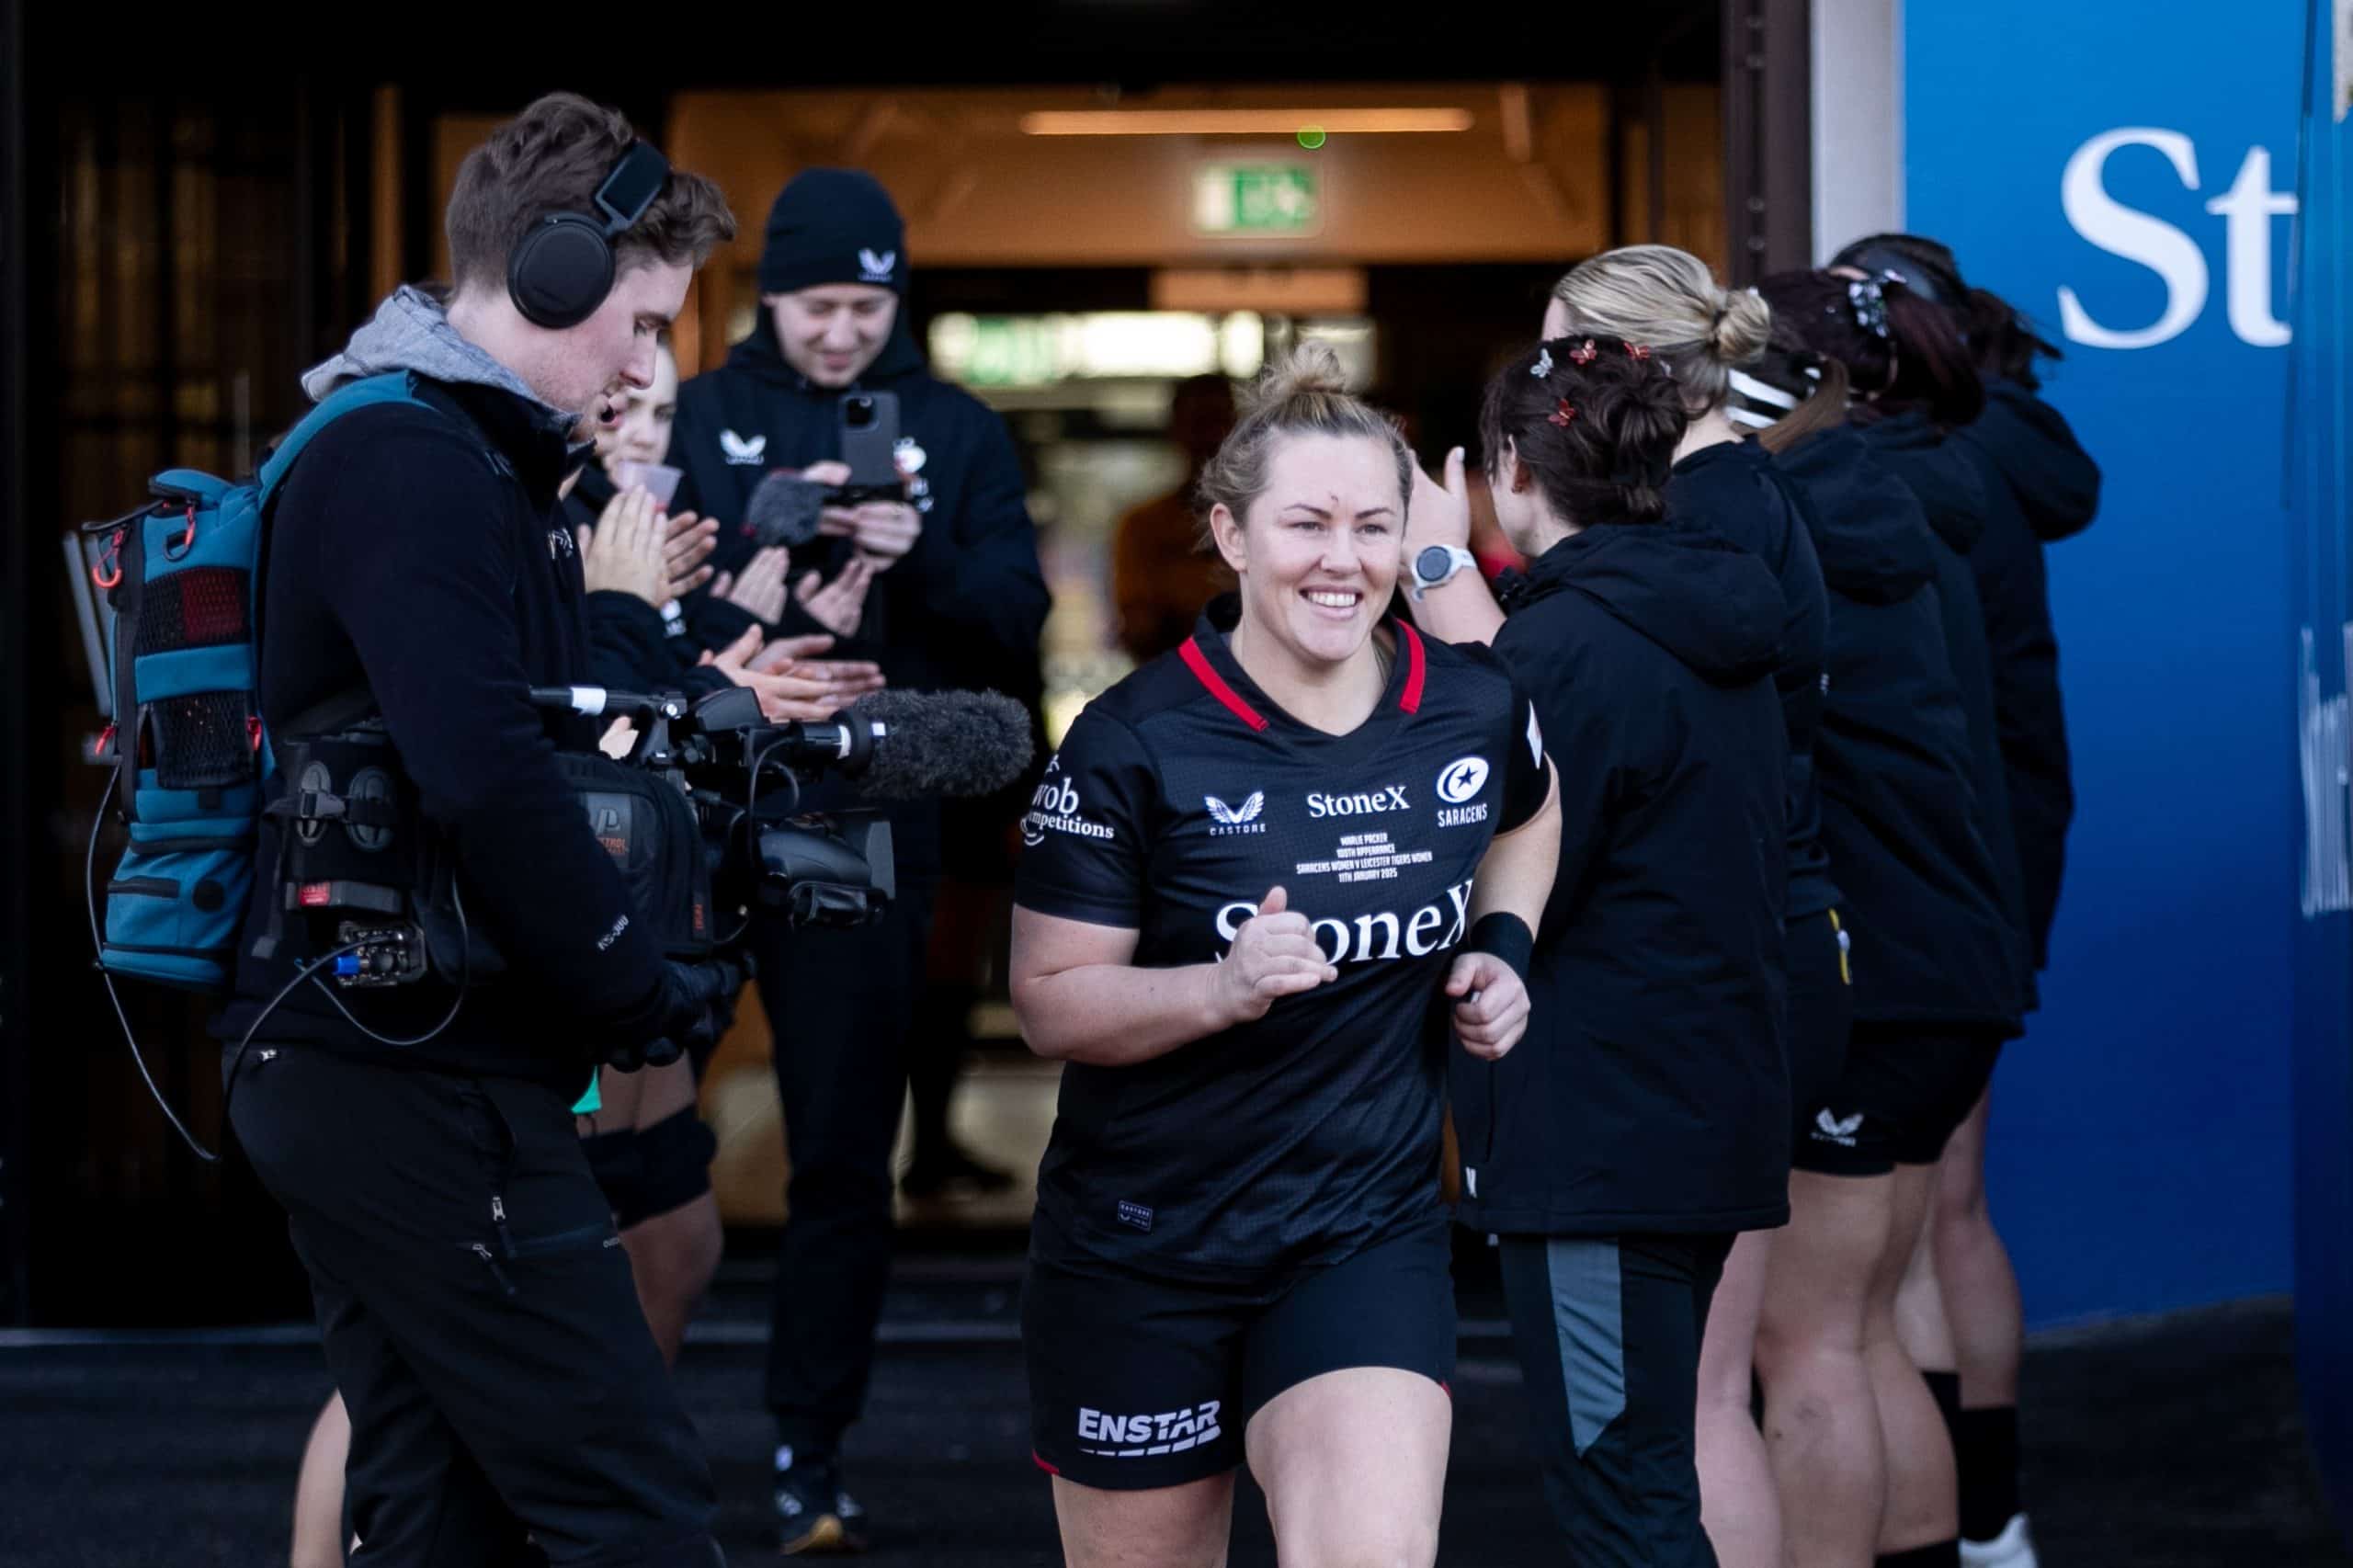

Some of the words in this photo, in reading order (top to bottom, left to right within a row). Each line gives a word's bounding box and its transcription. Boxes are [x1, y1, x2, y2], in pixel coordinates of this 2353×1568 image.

[1306, 786, 1411, 818] StoneX
[1438, 802, 1488, 827] SARACENS
[1210, 823, 1267, 835] CASTORE
[1296, 861, 1330, 874] SARACENS
[1331, 859, 1355, 871] WOMEN
[1360, 856, 1391, 869] LEICESTER
[1391, 854, 1411, 866] TIGERS
[1381, 867, 1398, 879] 2025
[1215, 880, 1472, 965] SoneX
[1078, 1400, 1221, 1443] ENSTAR
